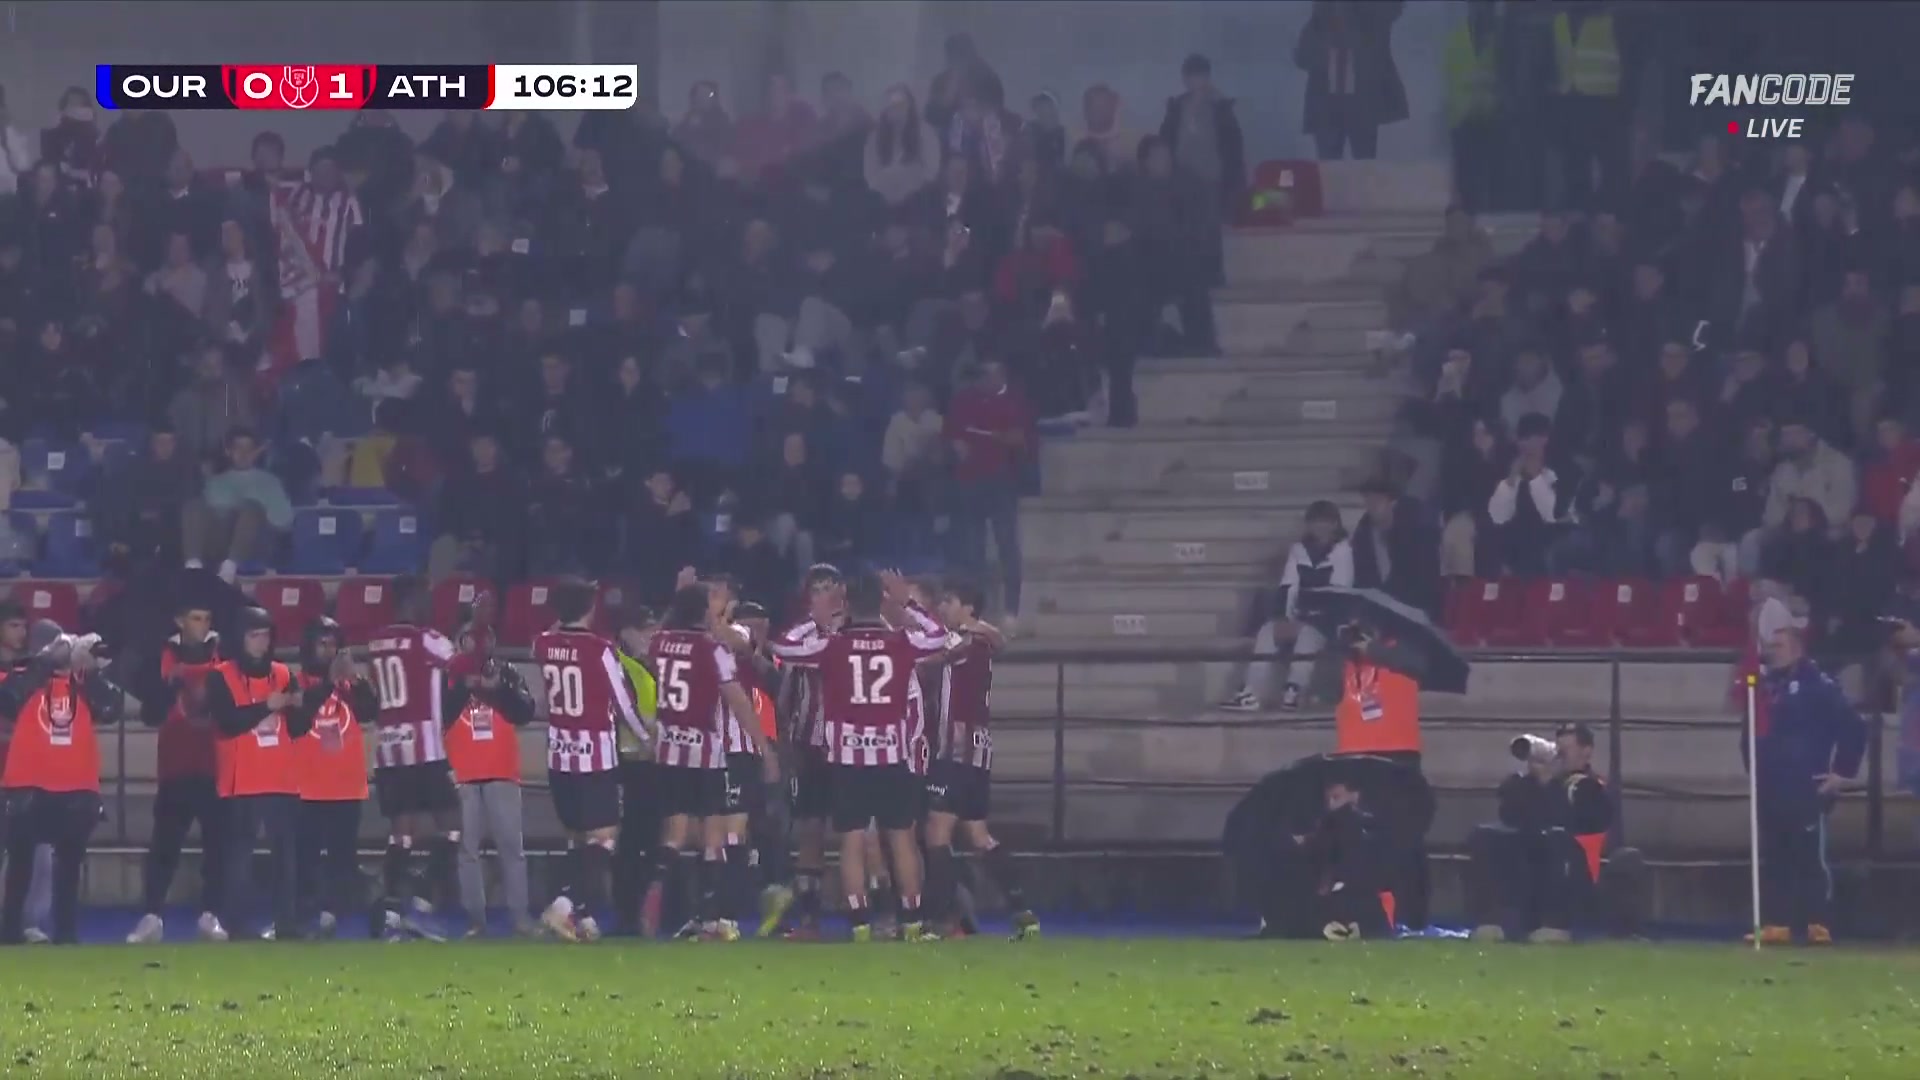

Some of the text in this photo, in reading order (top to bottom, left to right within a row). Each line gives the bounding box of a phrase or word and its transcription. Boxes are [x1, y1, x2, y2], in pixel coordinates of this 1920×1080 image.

[373, 656, 408, 710] 10
[543, 663, 584, 718] 20
[656, 657, 692, 712] 15
[848, 655, 894, 704] 12
